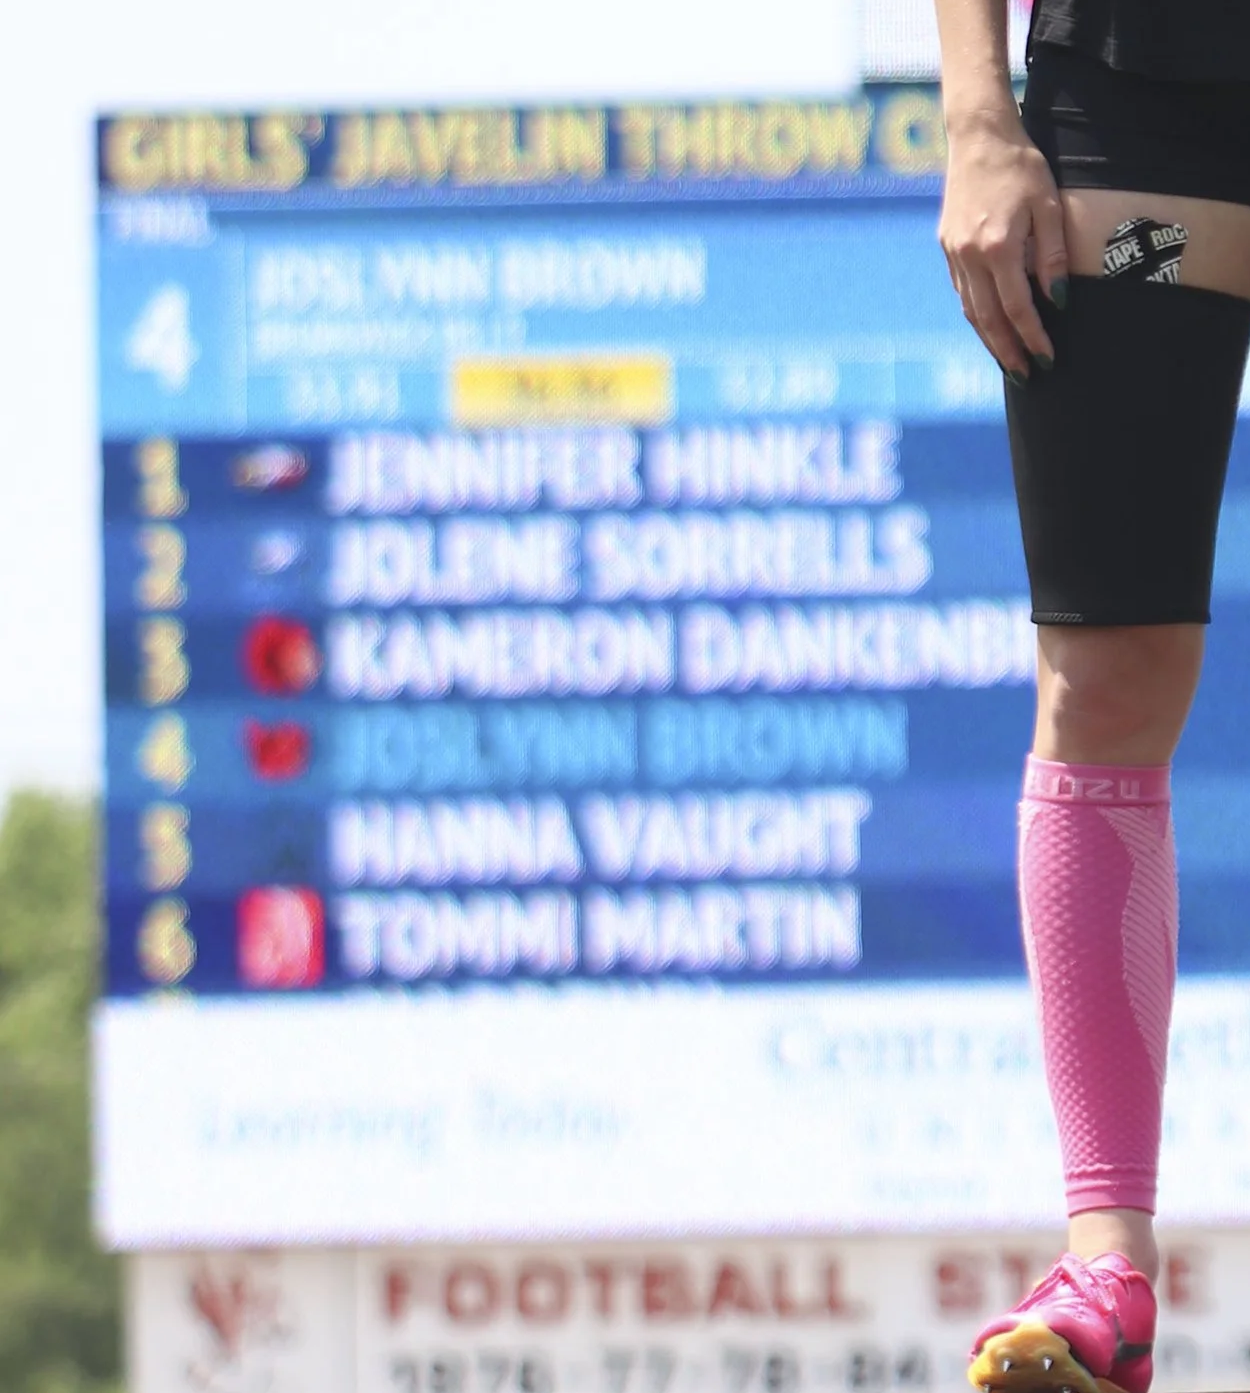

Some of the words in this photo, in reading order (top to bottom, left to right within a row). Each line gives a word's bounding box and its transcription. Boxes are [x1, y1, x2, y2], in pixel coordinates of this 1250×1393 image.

[333, 107, 605, 189] JAVELIN
[615, 101, 871, 182] THROW
[126, 282, 198, 392] 4
[327, 430, 642, 514] JENNIFER
[652, 423, 901, 507] HINKLE
[330, 515, 580, 607] JOLENE
[586, 508, 932, 603] SORRELLS
[326, 610, 673, 702] KAMERON
[330, 799, 582, 884] HANNA
[584, 789, 872, 881] VAUGHT
[336, 889, 580, 979] TOMMI
[582, 884, 861, 971] MARTIN
[384, 1255, 865, 1324] FOOTBALL
[934, 1243, 1195, 1315] STE
